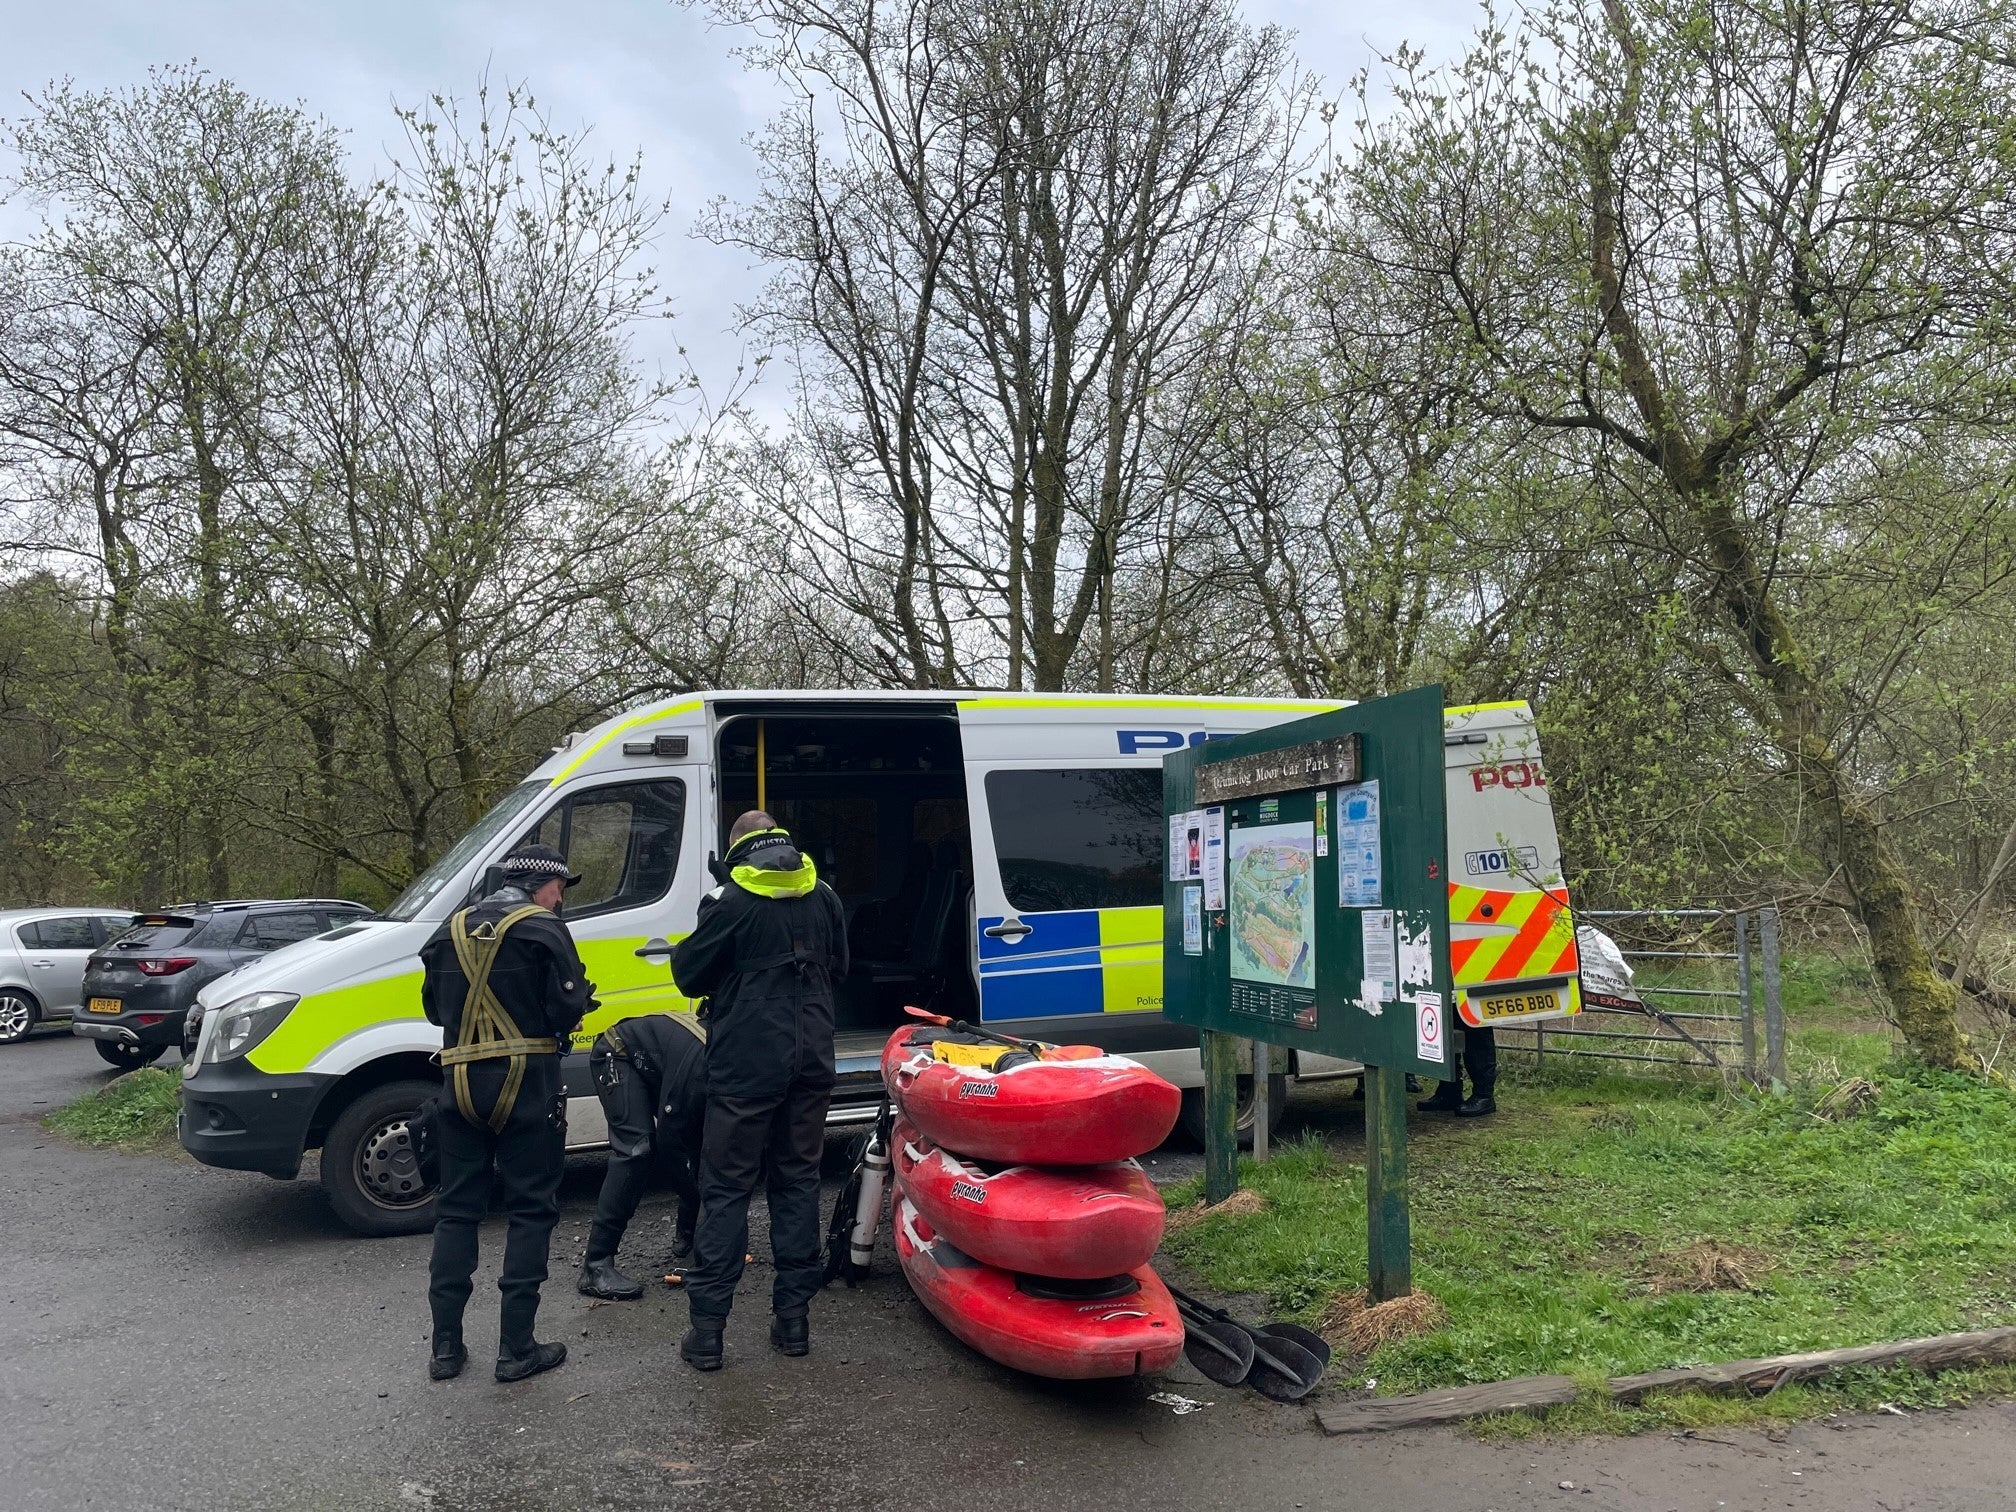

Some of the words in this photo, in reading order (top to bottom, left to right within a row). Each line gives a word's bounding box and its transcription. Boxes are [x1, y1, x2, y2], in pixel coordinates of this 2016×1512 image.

[1256, 767, 1278, 781] Moor
[1283, 764, 1299, 777] Car
[1305, 755, 1329, 773] Park
[751, 837, 786, 850] MUSTO
[1479, 852, 1509, 871] 101
[1582, 970, 1595, 978] the
[1136, 996, 1163, 1006] Police
[1486, 998, 1524, 1015] SF66
[1527, 994, 1554, 1011] BBO
[1585, 994, 1597, 1002] NO
[959, 1081, 998, 1098] pyranha
[950, 1181, 987, 1202] pyranha
